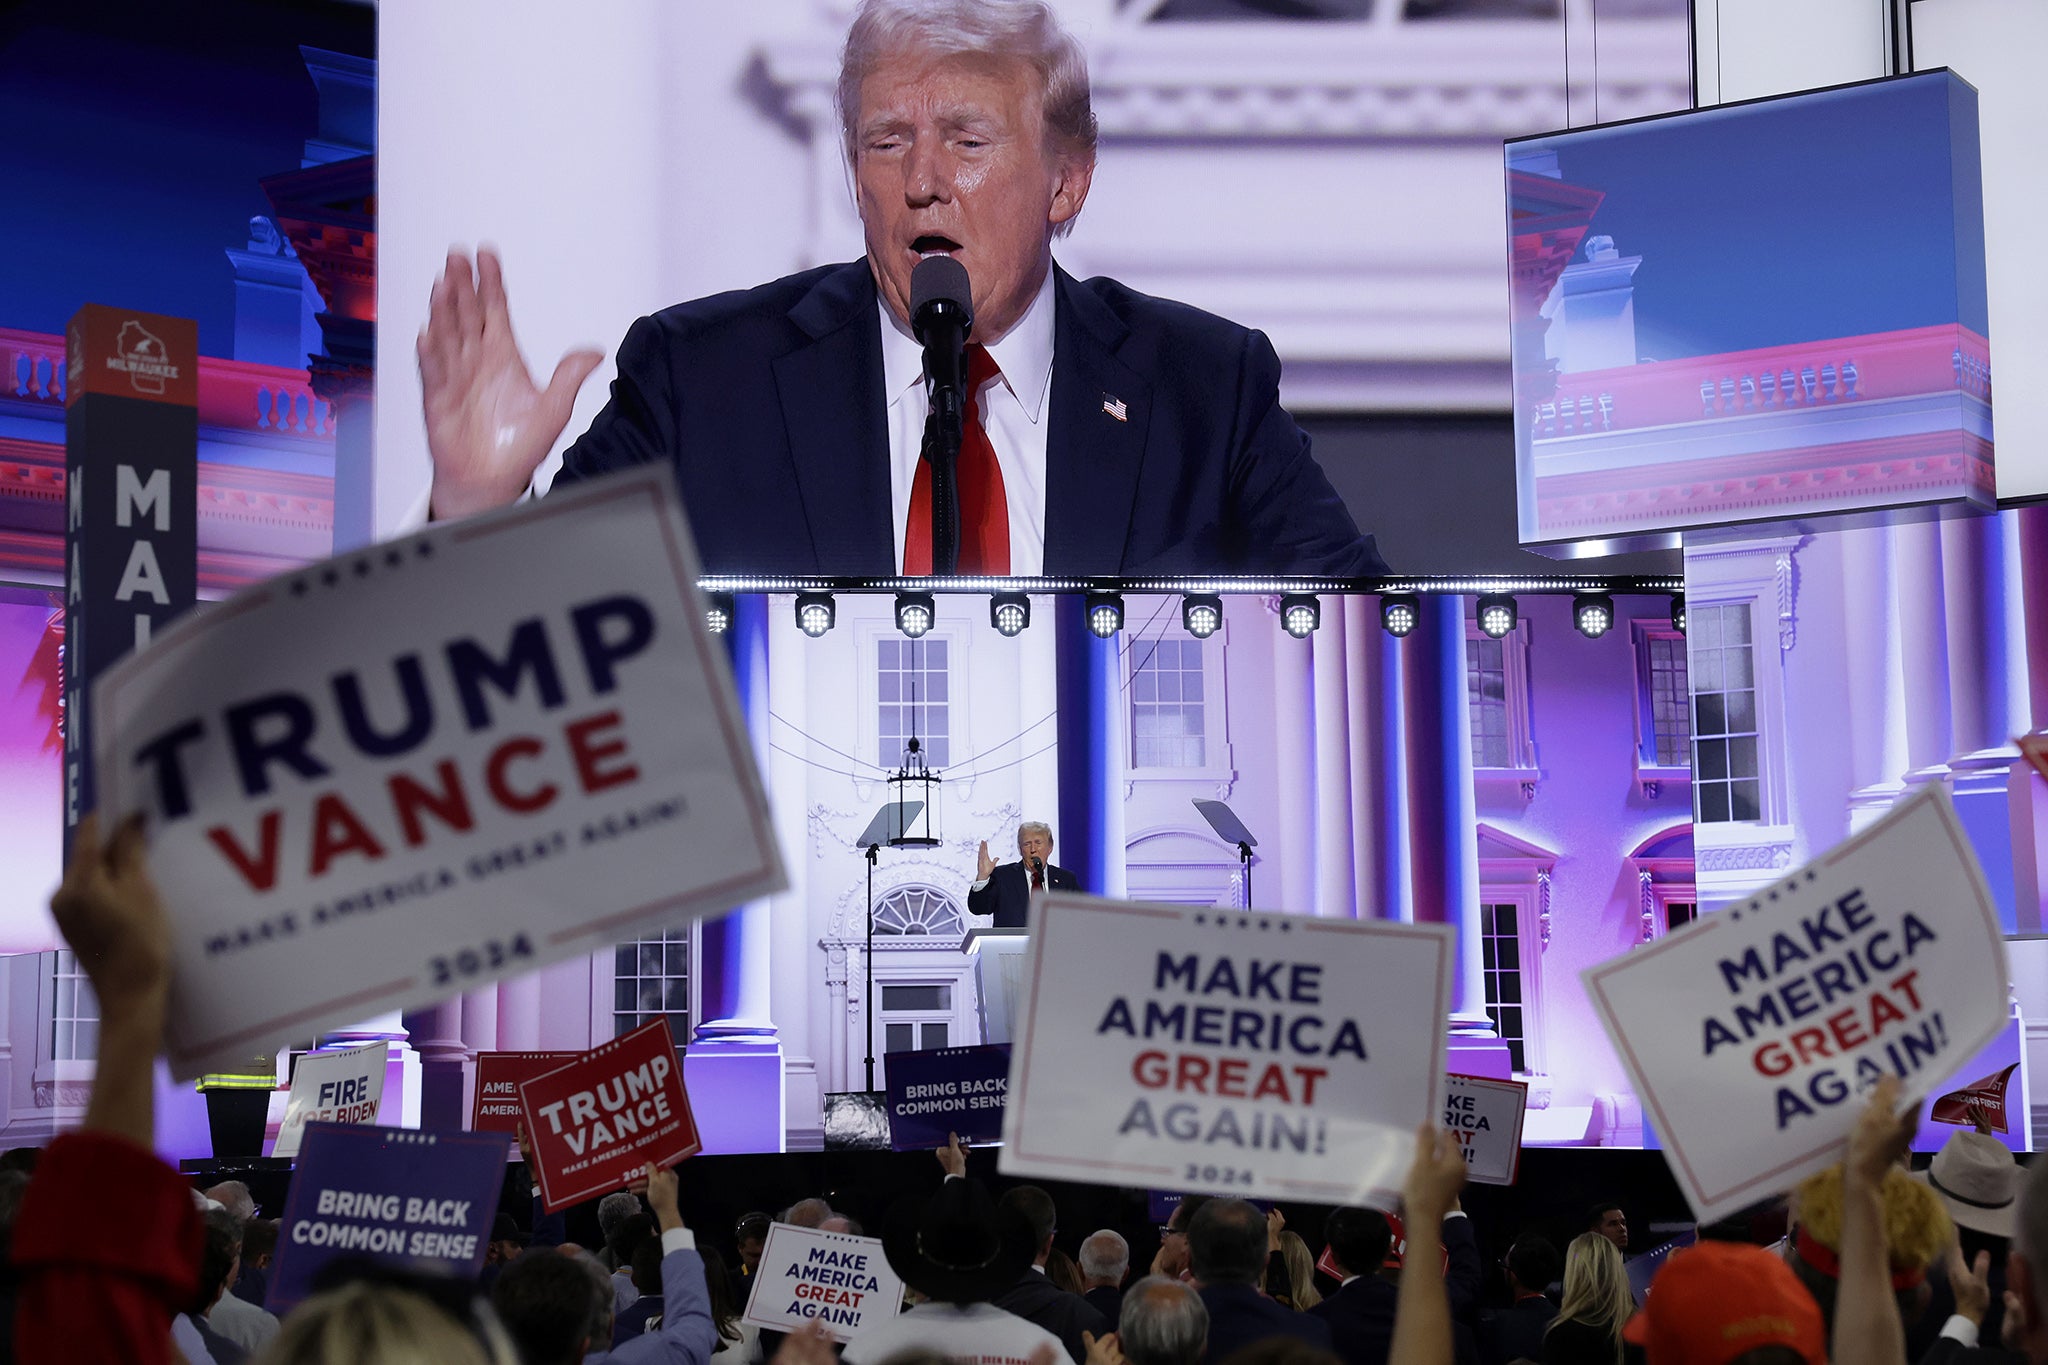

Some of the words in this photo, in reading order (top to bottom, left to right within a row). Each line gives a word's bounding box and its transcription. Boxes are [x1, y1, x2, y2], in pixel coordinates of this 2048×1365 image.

[107, 357, 178, 378] MILWAUKEE
[115, 464, 171, 655] MAI
[69, 465, 83, 827] MAINE
[134, 596, 655, 821] TRUMP
[207, 709, 641, 894] VANCE
[205, 913, 298, 956] MAKE
[311, 866, 456, 925] AMERICA
[465, 832, 565, 880] GREAT
[428, 932, 534, 986] 2024
[1719, 888, 1875, 994] MAKE
[1155, 951, 1323, 1005] MAKE
[1703, 912, 1936, 1055] AMERICA
[1098, 996, 1368, 1061] AMERICA
[1753, 969, 1922, 1077] GREAT
[317, 1075, 369, 1107] FIRE
[906, 1082, 956, 1099] BRING
[961, 1078, 1008, 1094] BACK
[1132, 1050, 1328, 1106] GREAT
[1775, 1012, 1947, 1130] AGAIN!
[289, 1110, 332, 1128] JOE
[336, 1099, 377, 1124] BIDEN
[539, 1055, 670, 1135] TRUMP
[896, 1098, 965, 1115] COMMON
[970, 1095, 1009, 1109] SENS
[1447, 1094, 1475, 1111] KE
[1980, 1098, 2001, 1110] FIRST
[563, 1092, 671, 1155] VANCE
[1119, 1097, 1327, 1155] AGAIN!
[1444, 1112, 1490, 1131] RICA
[562, 1160, 589, 1175] MAKE
[592, 1143, 634, 1164] AMERICA
[636, 1131, 658, 1147] GREAT
[623, 1165, 648, 1182] 202
[1185, 1164, 1254, 1185] 2024
[317, 1189, 400, 1221] BRING
[405, 1197, 471, 1227] BACK
[292, 1220, 405, 1254] COMMON
[409, 1232, 478, 1259] SENSE
[808, 1248, 867, 1270] MAKE
[785, 1263, 879, 1292] AMERICA
[795, 1283, 864, 1308] GREAT
[786, 1301, 862, 1327] AGAIN!
